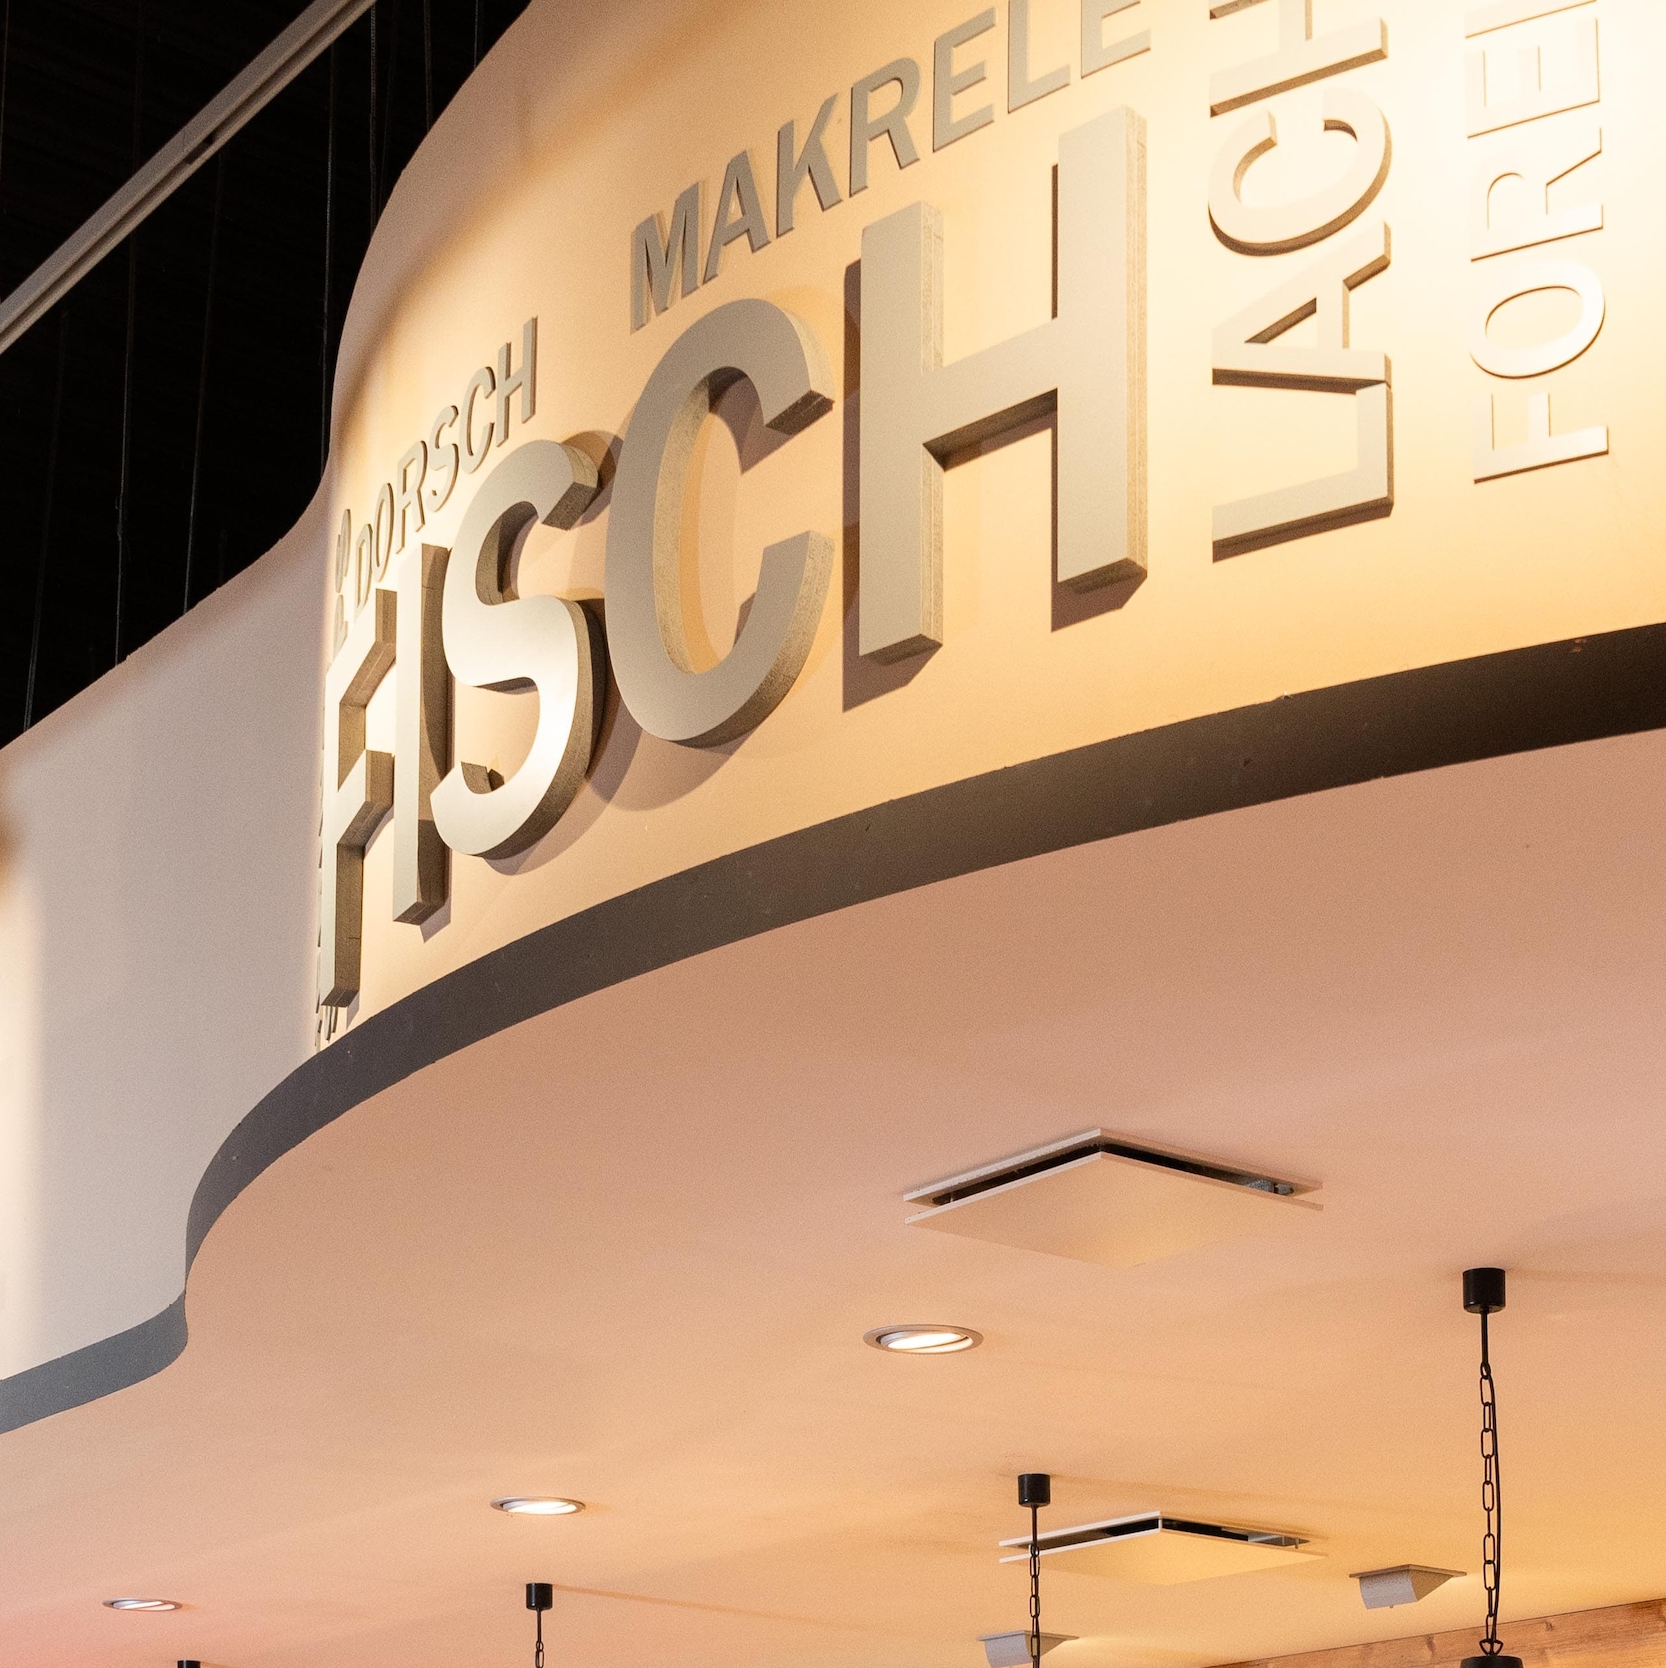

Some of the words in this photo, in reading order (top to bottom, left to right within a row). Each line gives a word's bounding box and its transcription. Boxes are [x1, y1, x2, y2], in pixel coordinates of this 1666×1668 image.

[629, 0, 1153, 332] MAKRELE
[319, 103, 1149, 1008] FISCH
[355, 314, 539, 622] DORSCH
